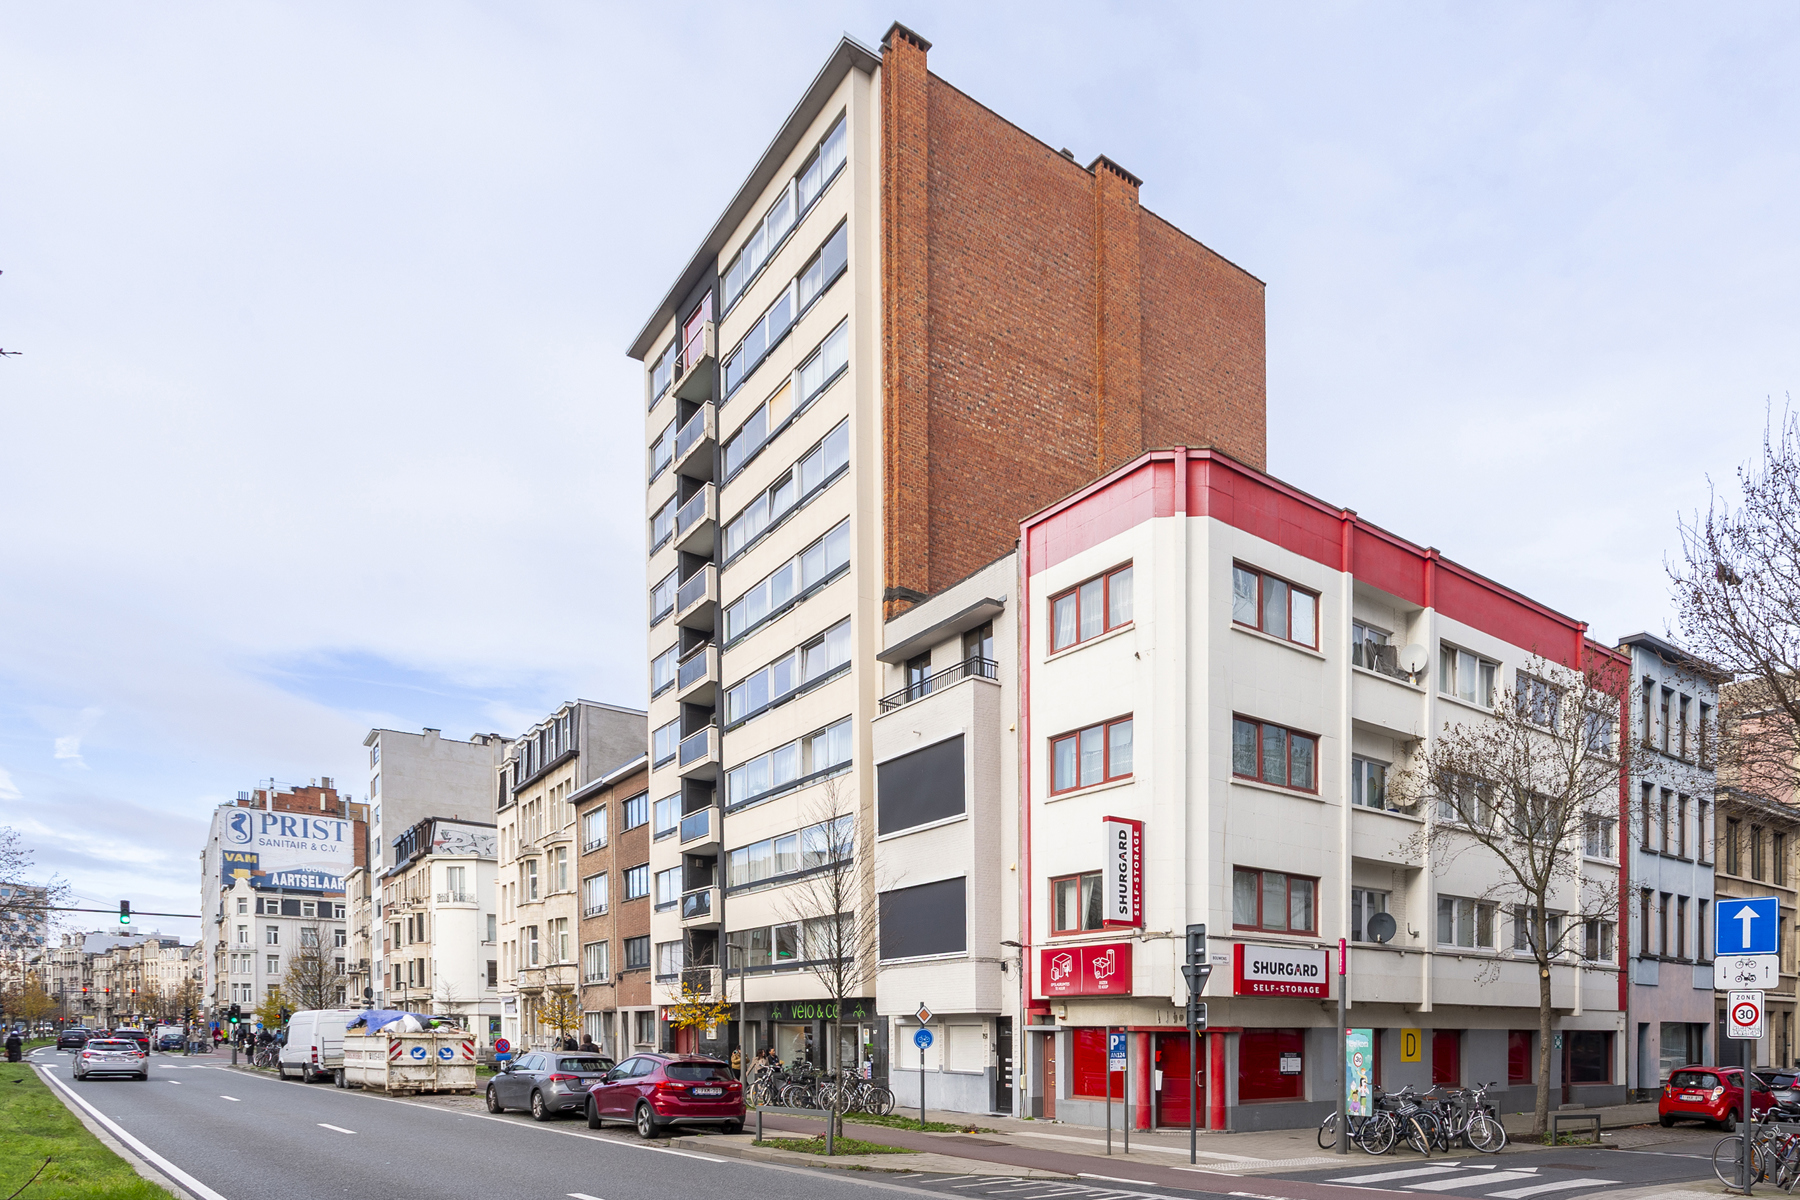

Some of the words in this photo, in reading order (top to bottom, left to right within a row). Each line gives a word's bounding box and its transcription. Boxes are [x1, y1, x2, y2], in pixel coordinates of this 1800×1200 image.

[259, 812, 349, 843] PRIST
[259, 838, 307, 850] SANITAIR
[311, 842, 319, 851] &
[321, 844, 340, 853] C.V.
[224, 852, 258, 864] VAM
[1119, 829, 1128, 915] SHURGARD
[272, 872, 346, 890] AARTSELAAR
[1253, 960, 1319, 977] SHURGARD
[1253, 983, 1320, 994] SELF-STORAGE
[817, 1004, 824, 1019] &
[1737, 1009, 1754, 1020] 30
[1110, 1035, 1119, 1051] P
[1406, 1033, 1416, 1057] D
